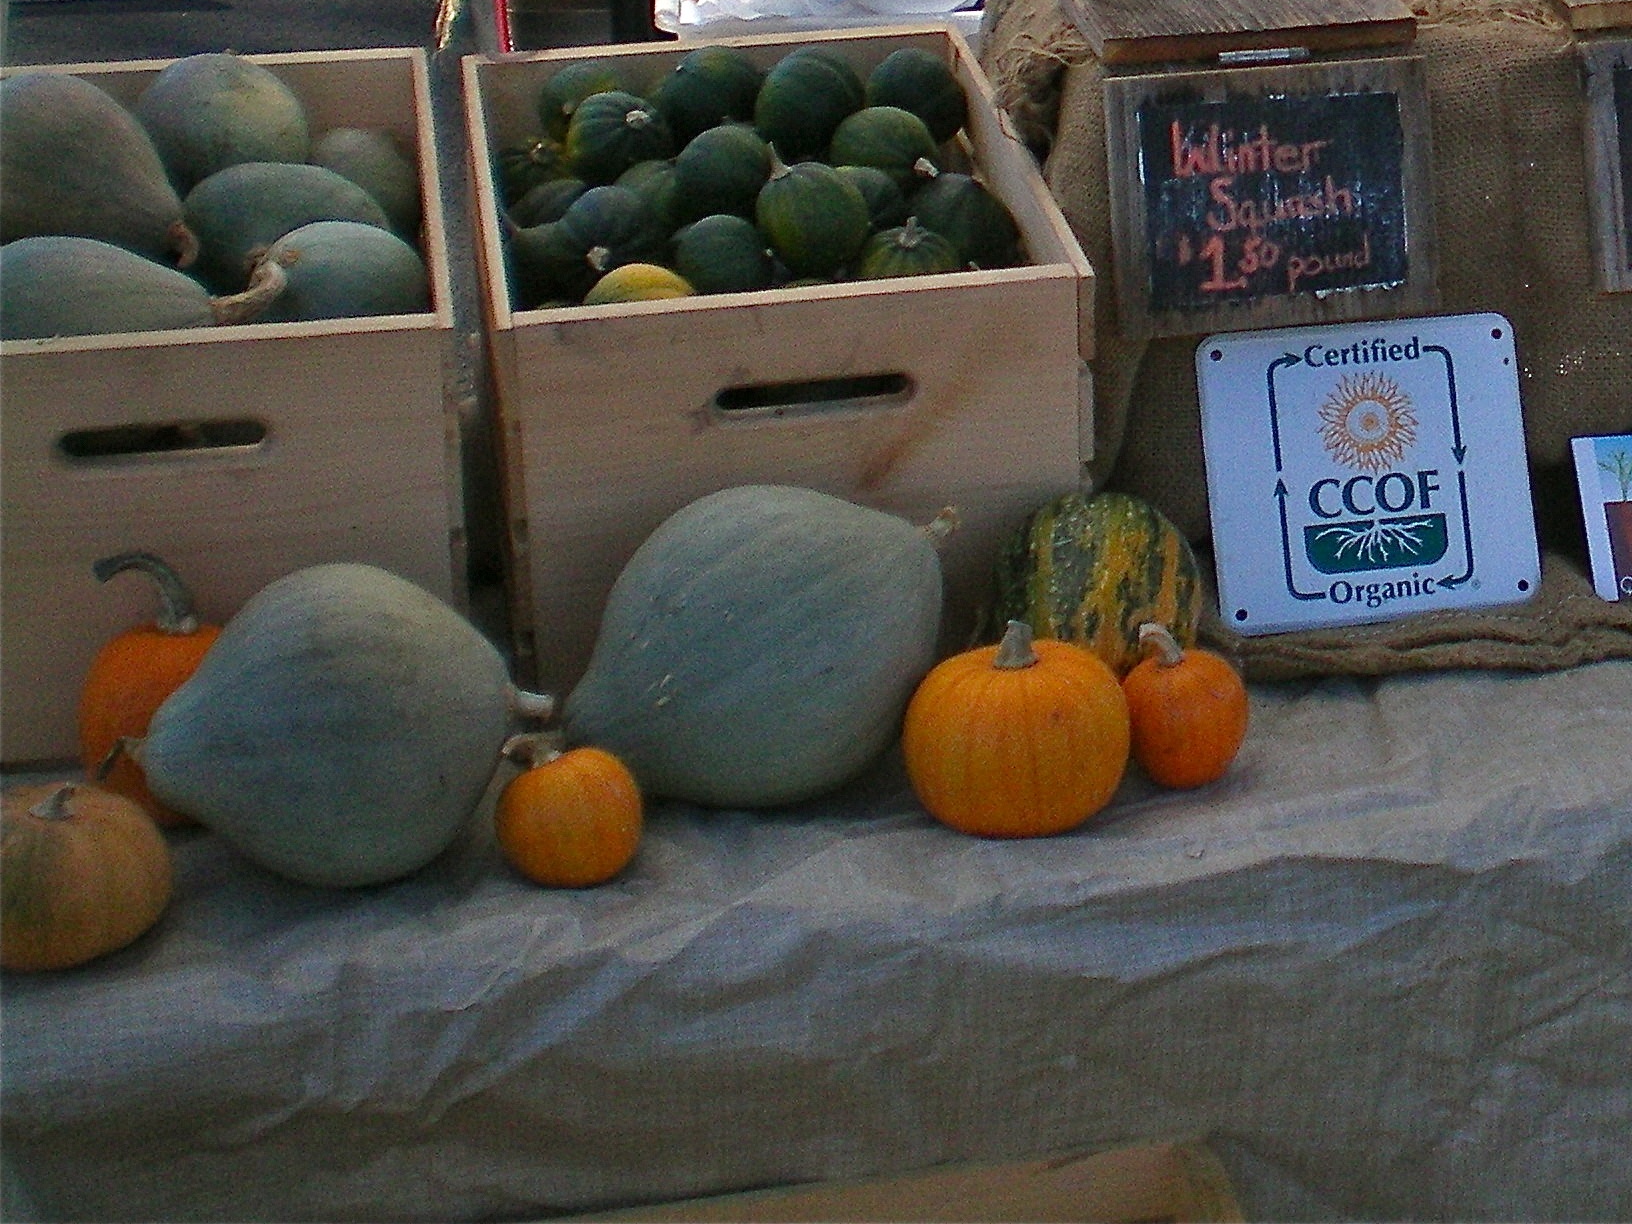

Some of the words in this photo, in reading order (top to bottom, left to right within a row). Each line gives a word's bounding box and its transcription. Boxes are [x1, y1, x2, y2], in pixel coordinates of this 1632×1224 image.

[1170, 120, 1334, 179] Winter
[1206, 175, 1354, 235] Squash
[1286, 232, 1370, 293] pound
[1303, 336, 1420, 368] Certified
[1308, 469, 1440, 519] CCOF
[1329, 572, 1437, 608] Organic
